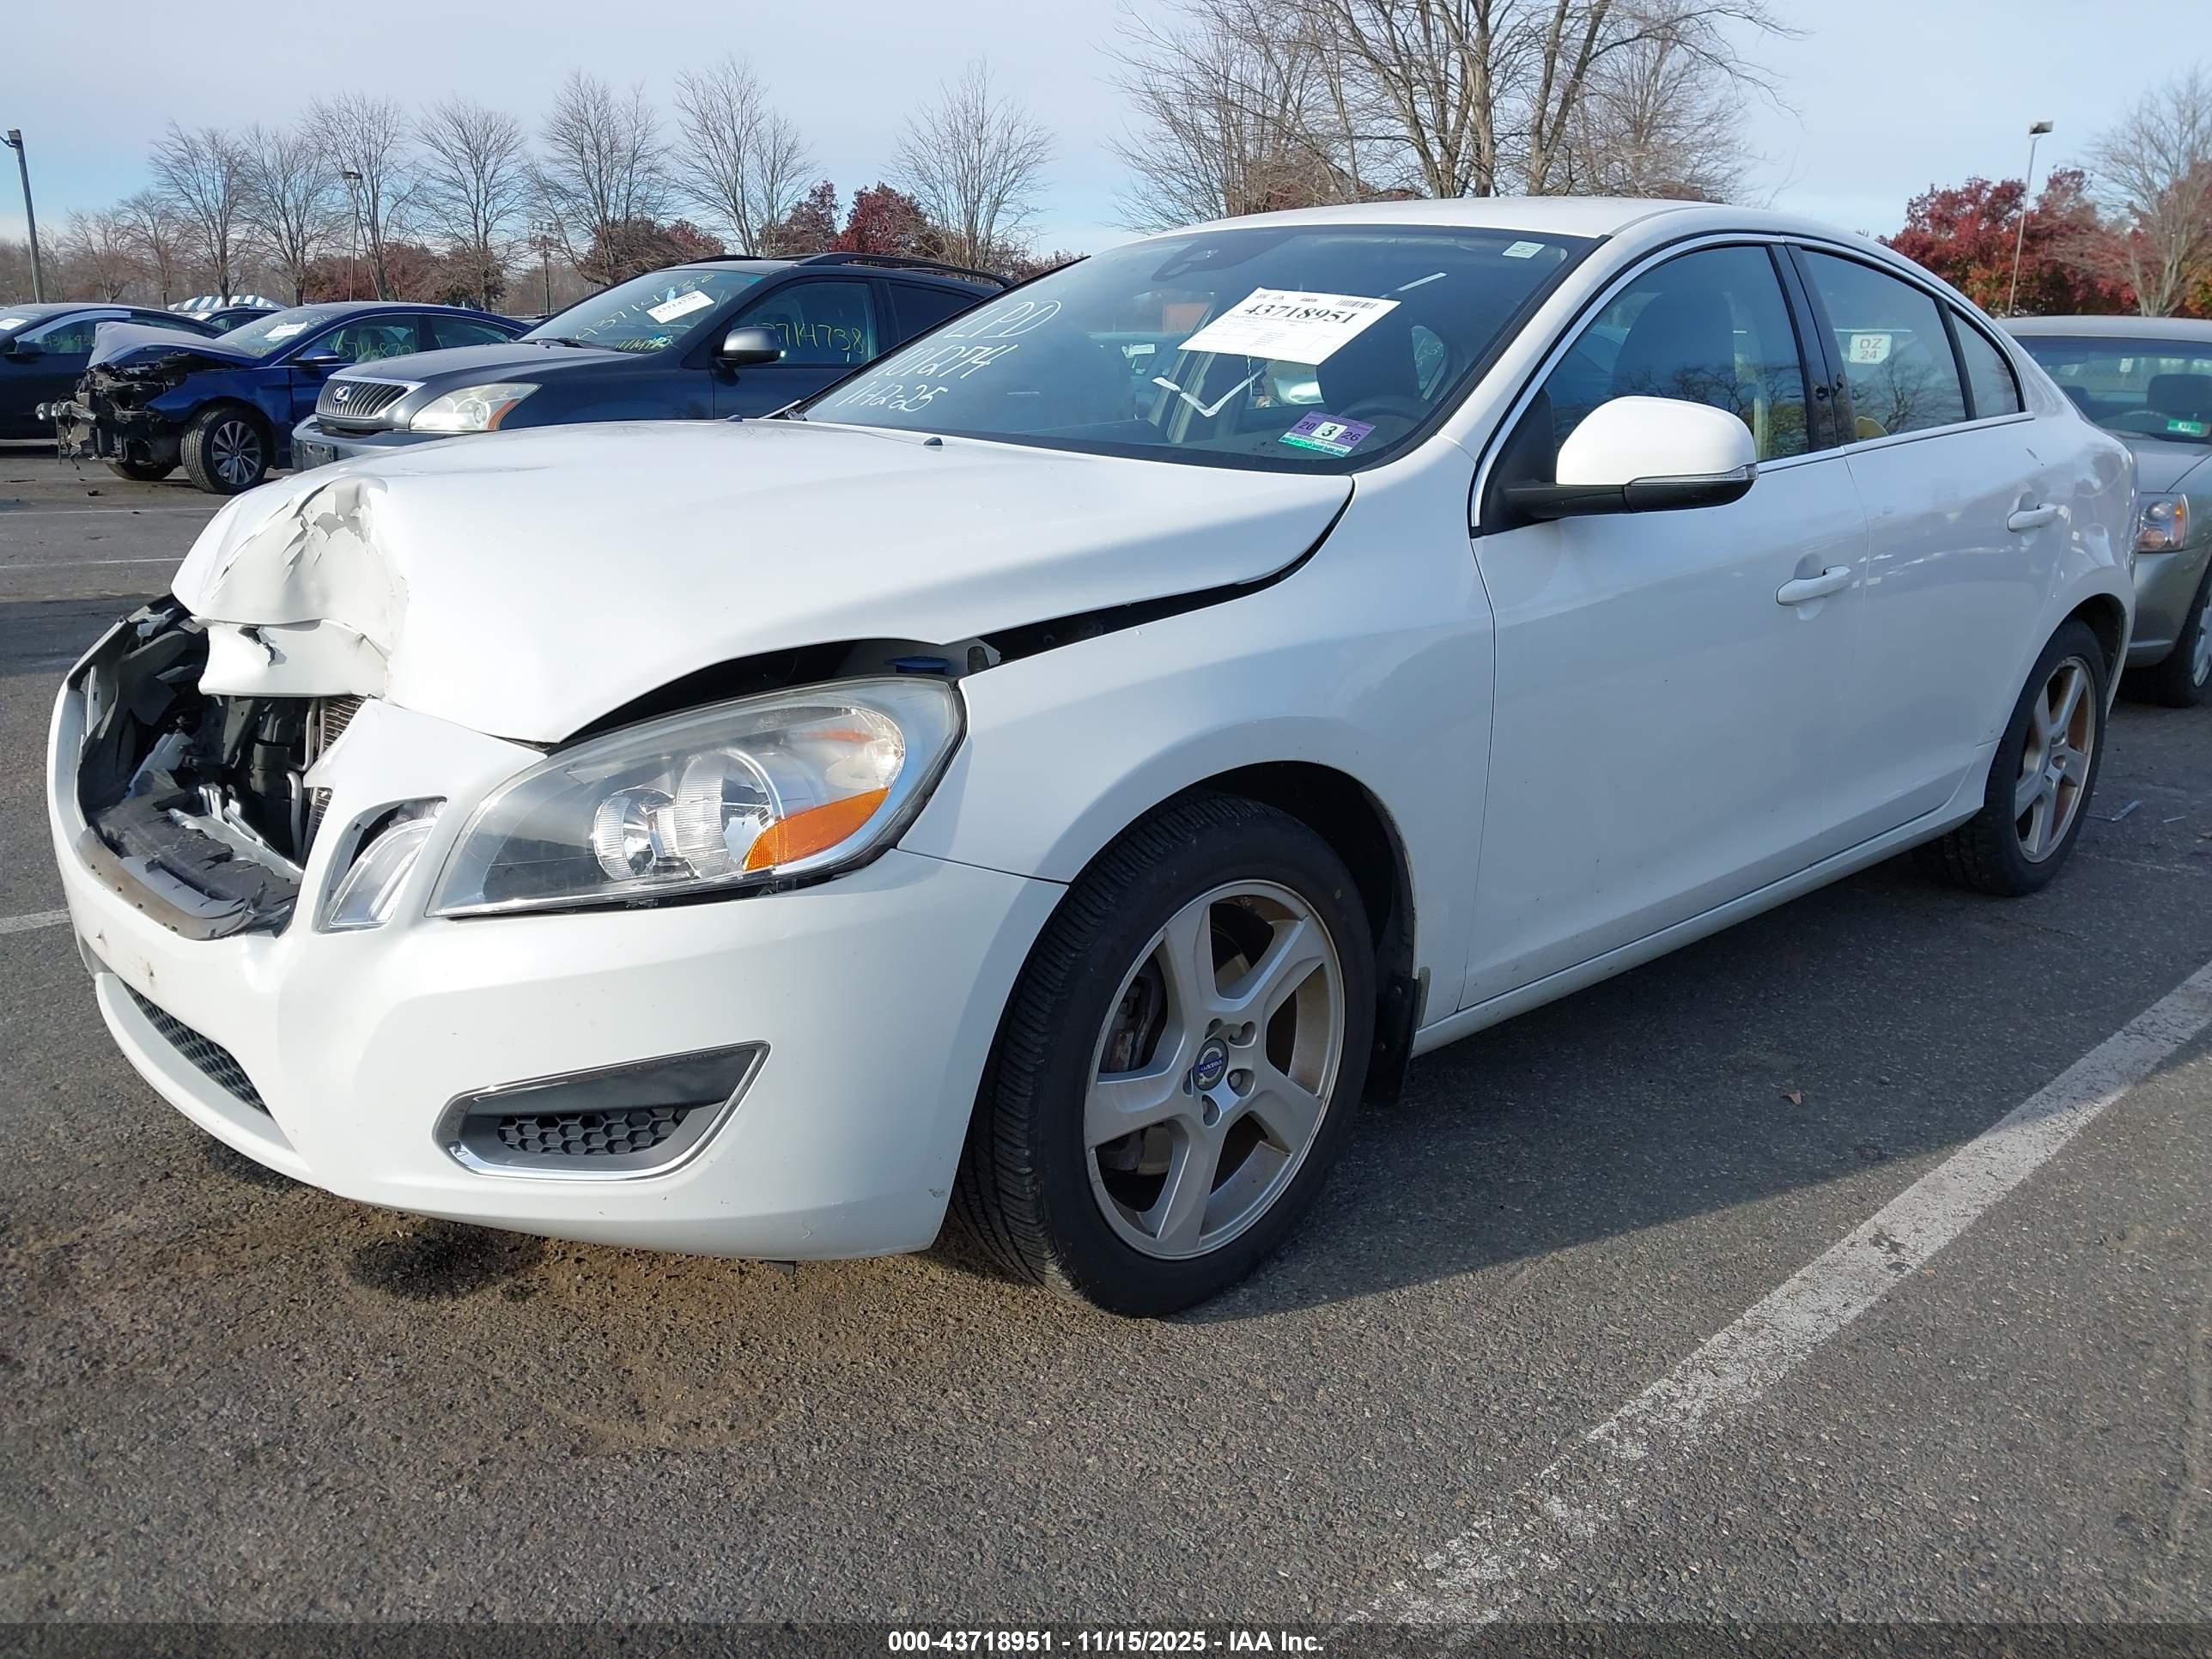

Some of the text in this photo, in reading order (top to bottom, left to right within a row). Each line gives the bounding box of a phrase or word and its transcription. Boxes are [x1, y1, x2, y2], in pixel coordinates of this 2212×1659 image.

[943, 301, 1061, 338] LPD
[1243, 304, 1358, 324] 43718951
[1297, 421, 1316, 430] 20
[1322, 425, 1338, 437] 3
[1341, 431, 1361, 441] 26
[1200, 1059, 1223, 1071] VOLVO
